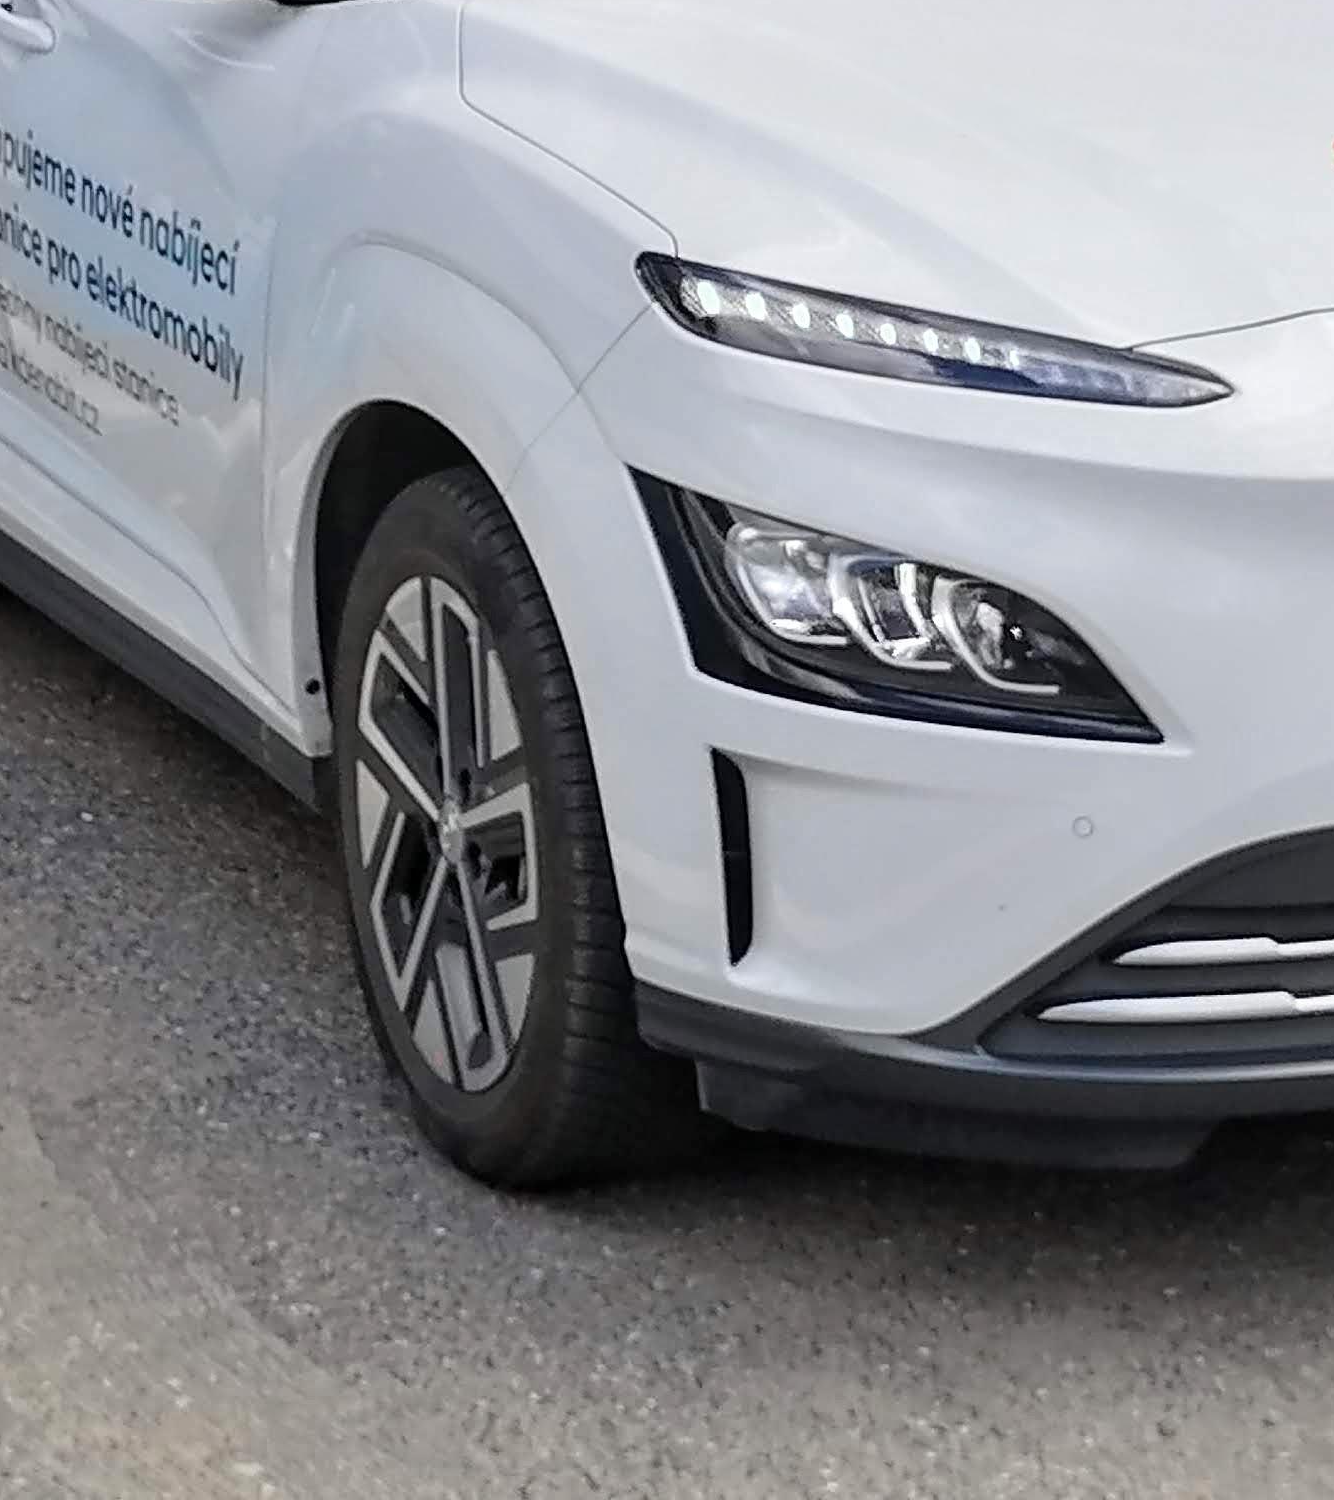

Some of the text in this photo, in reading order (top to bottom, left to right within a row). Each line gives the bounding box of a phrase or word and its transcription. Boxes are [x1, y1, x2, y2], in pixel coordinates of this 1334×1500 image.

[82, 175, 134, 238] nové
[140, 209, 241, 295] nabíjecí
[48, 239, 82, 290] pro
[86, 255, 244, 402] elektromobily
